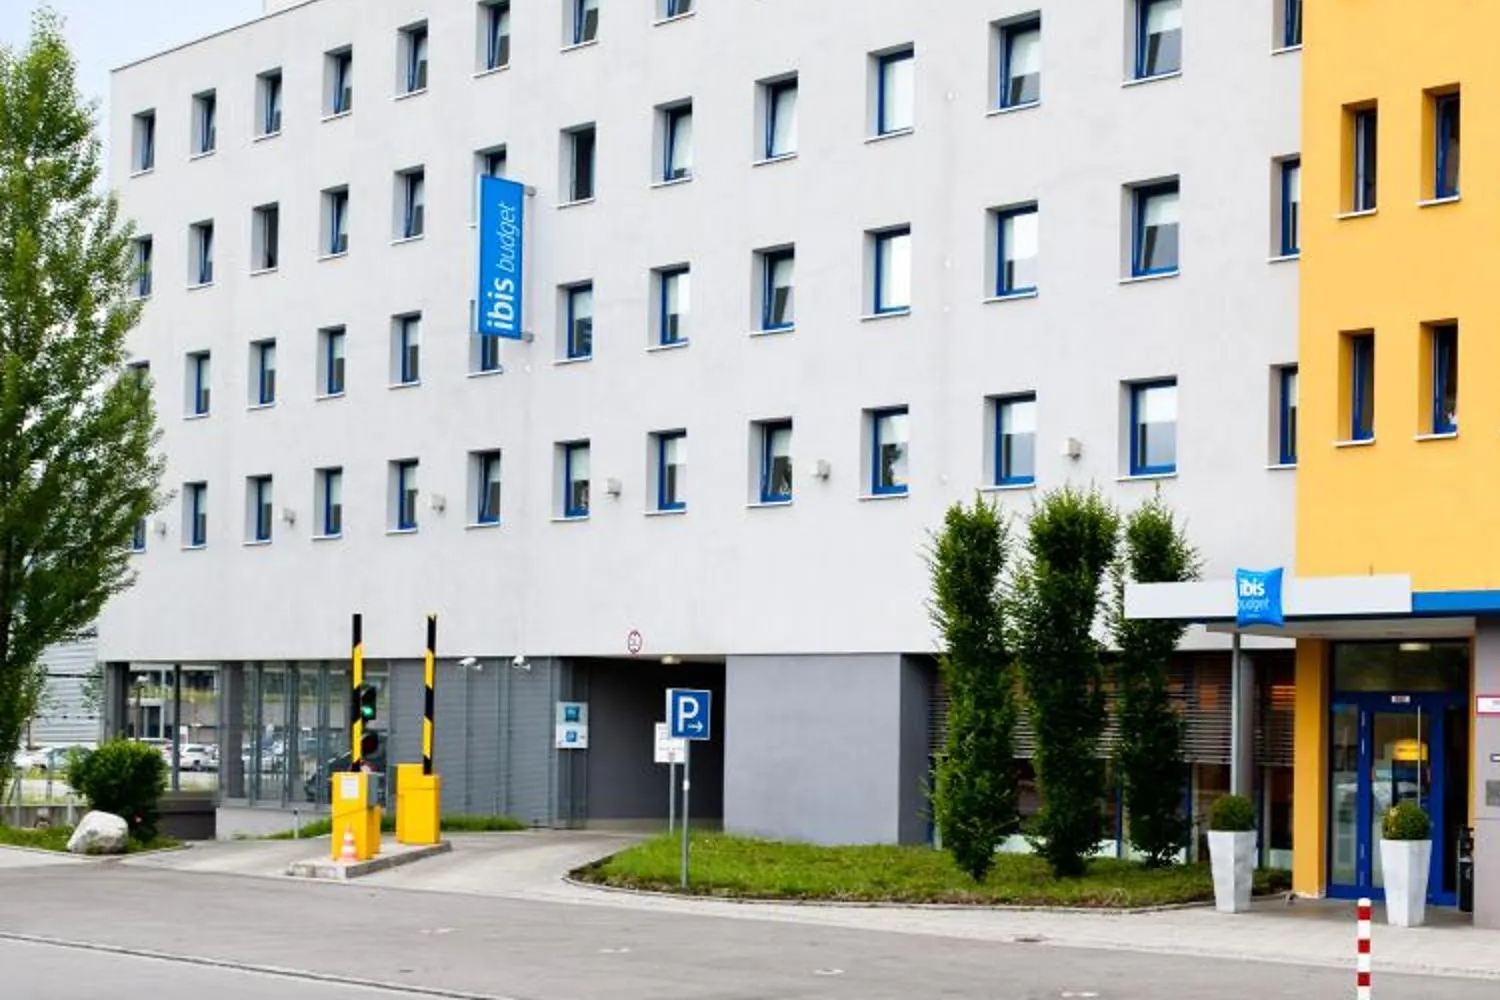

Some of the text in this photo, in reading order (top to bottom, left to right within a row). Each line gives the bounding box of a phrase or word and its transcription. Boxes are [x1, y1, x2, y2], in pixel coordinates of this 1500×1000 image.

[487, 202, 520, 330] ibis budget
[1239, 577, 1265, 597] ibis
[678, 695, 699, 733] P
